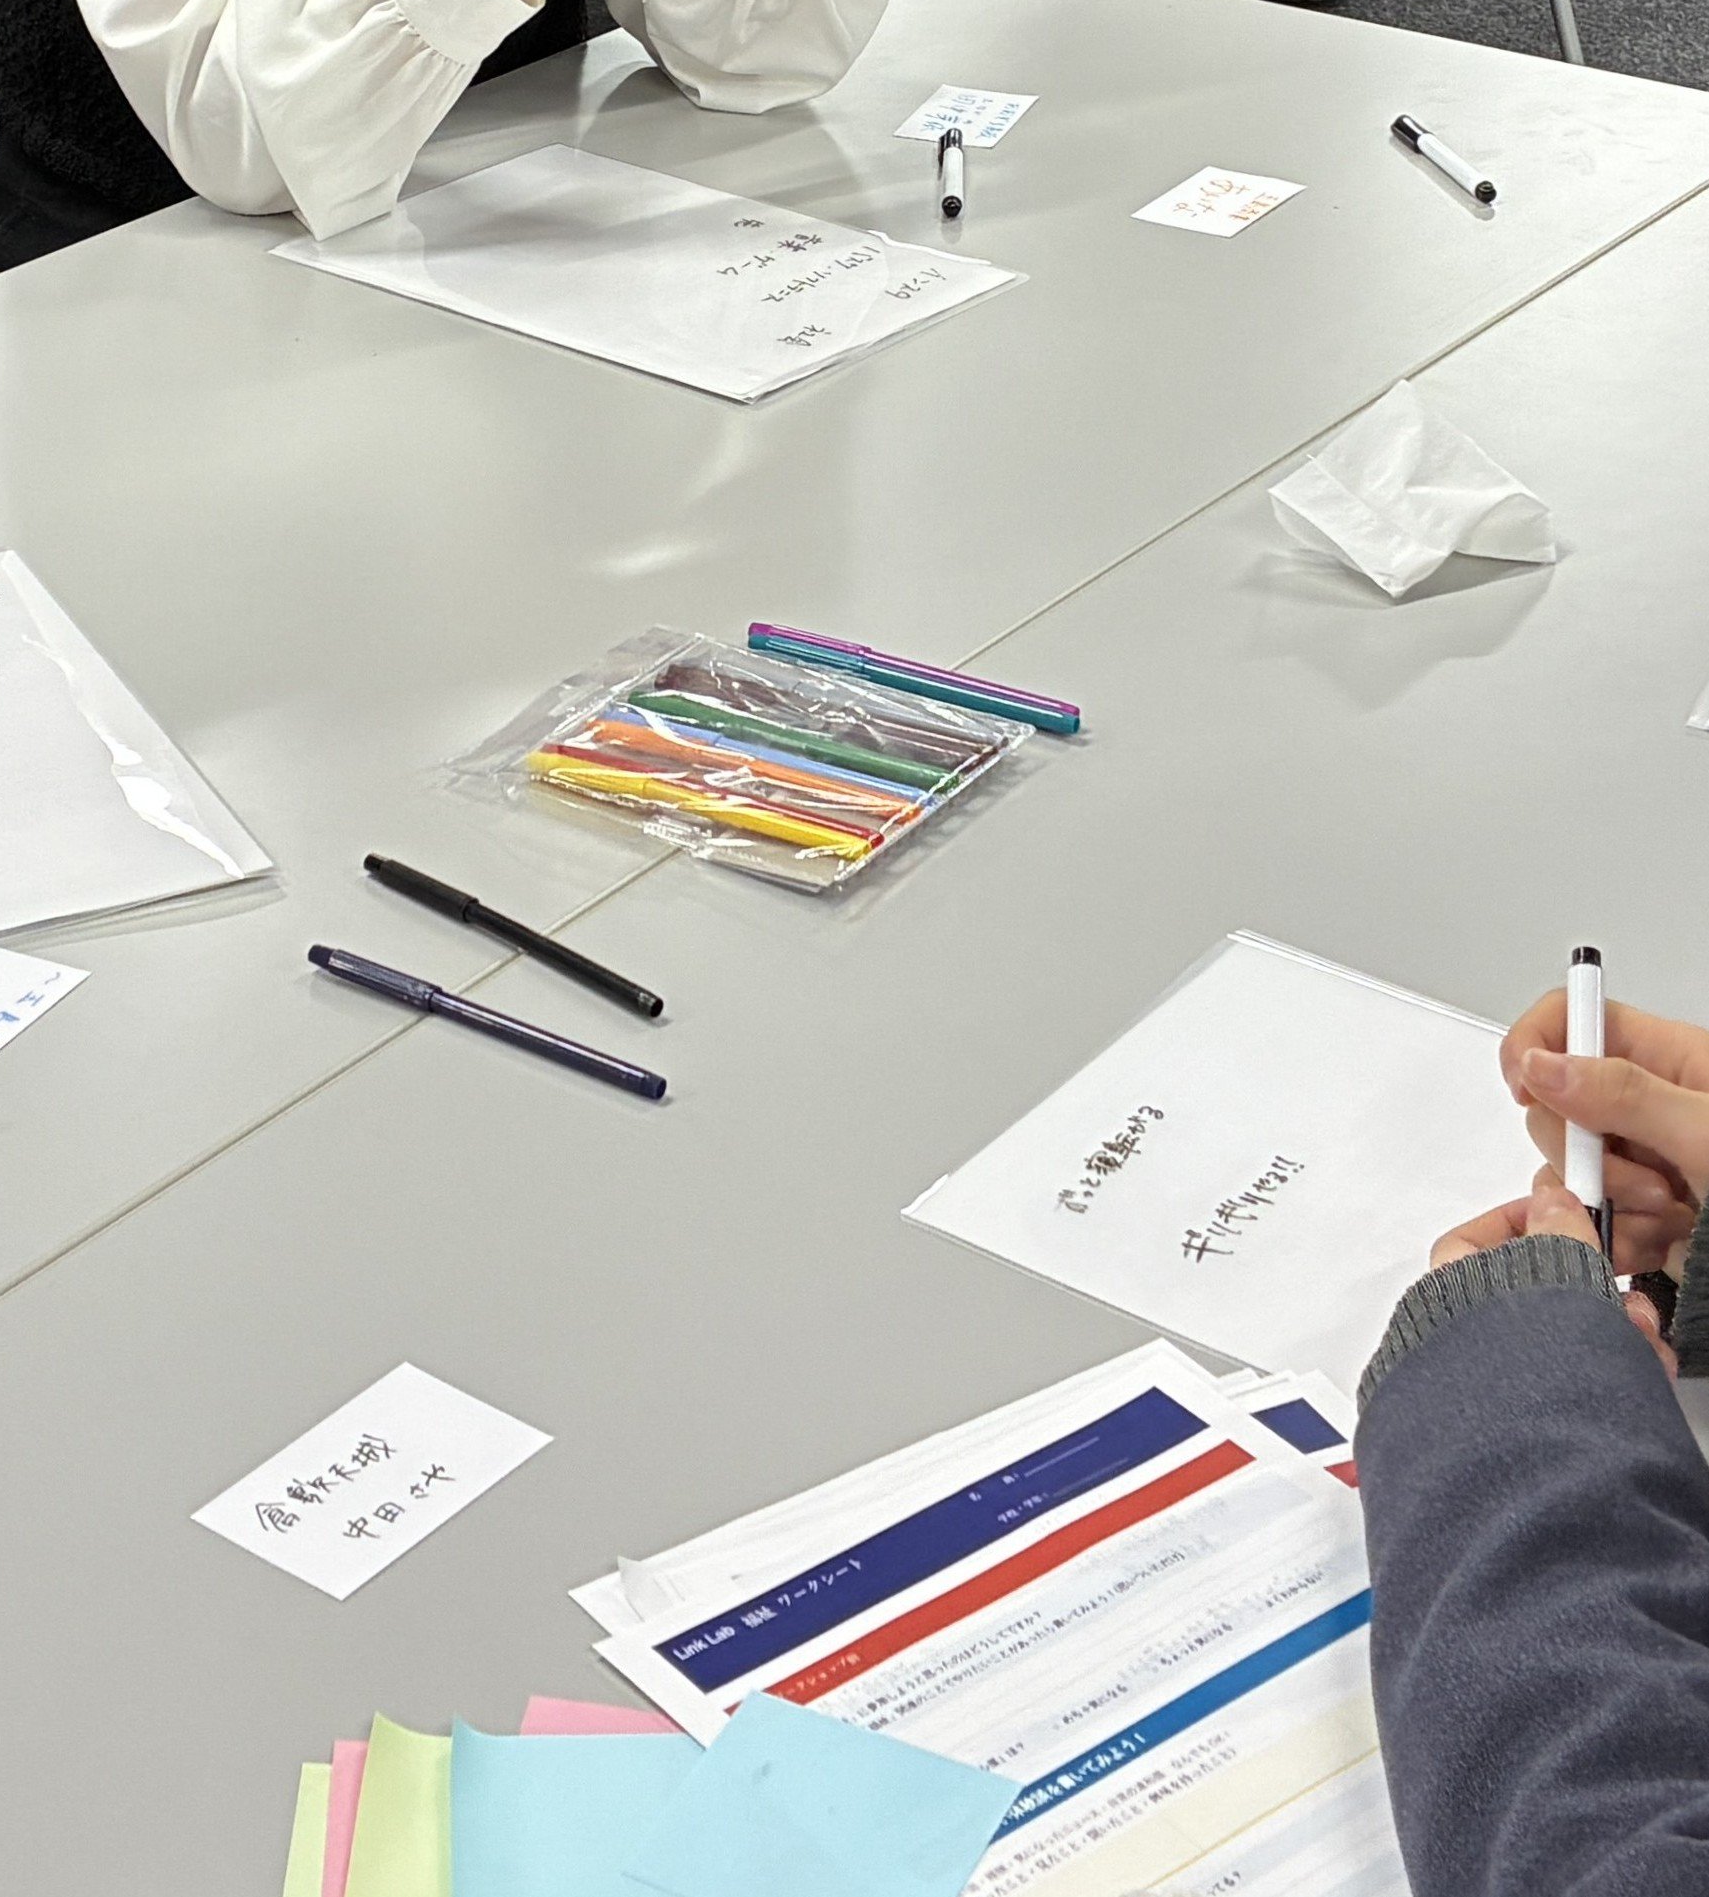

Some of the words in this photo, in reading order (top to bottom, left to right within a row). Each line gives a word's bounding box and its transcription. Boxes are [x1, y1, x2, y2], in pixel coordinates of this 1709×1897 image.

[672, 1639, 709, 1661] Link
[704, 1626, 736, 1645] Lab
[777, 1559, 861, 1607] ワークシート
